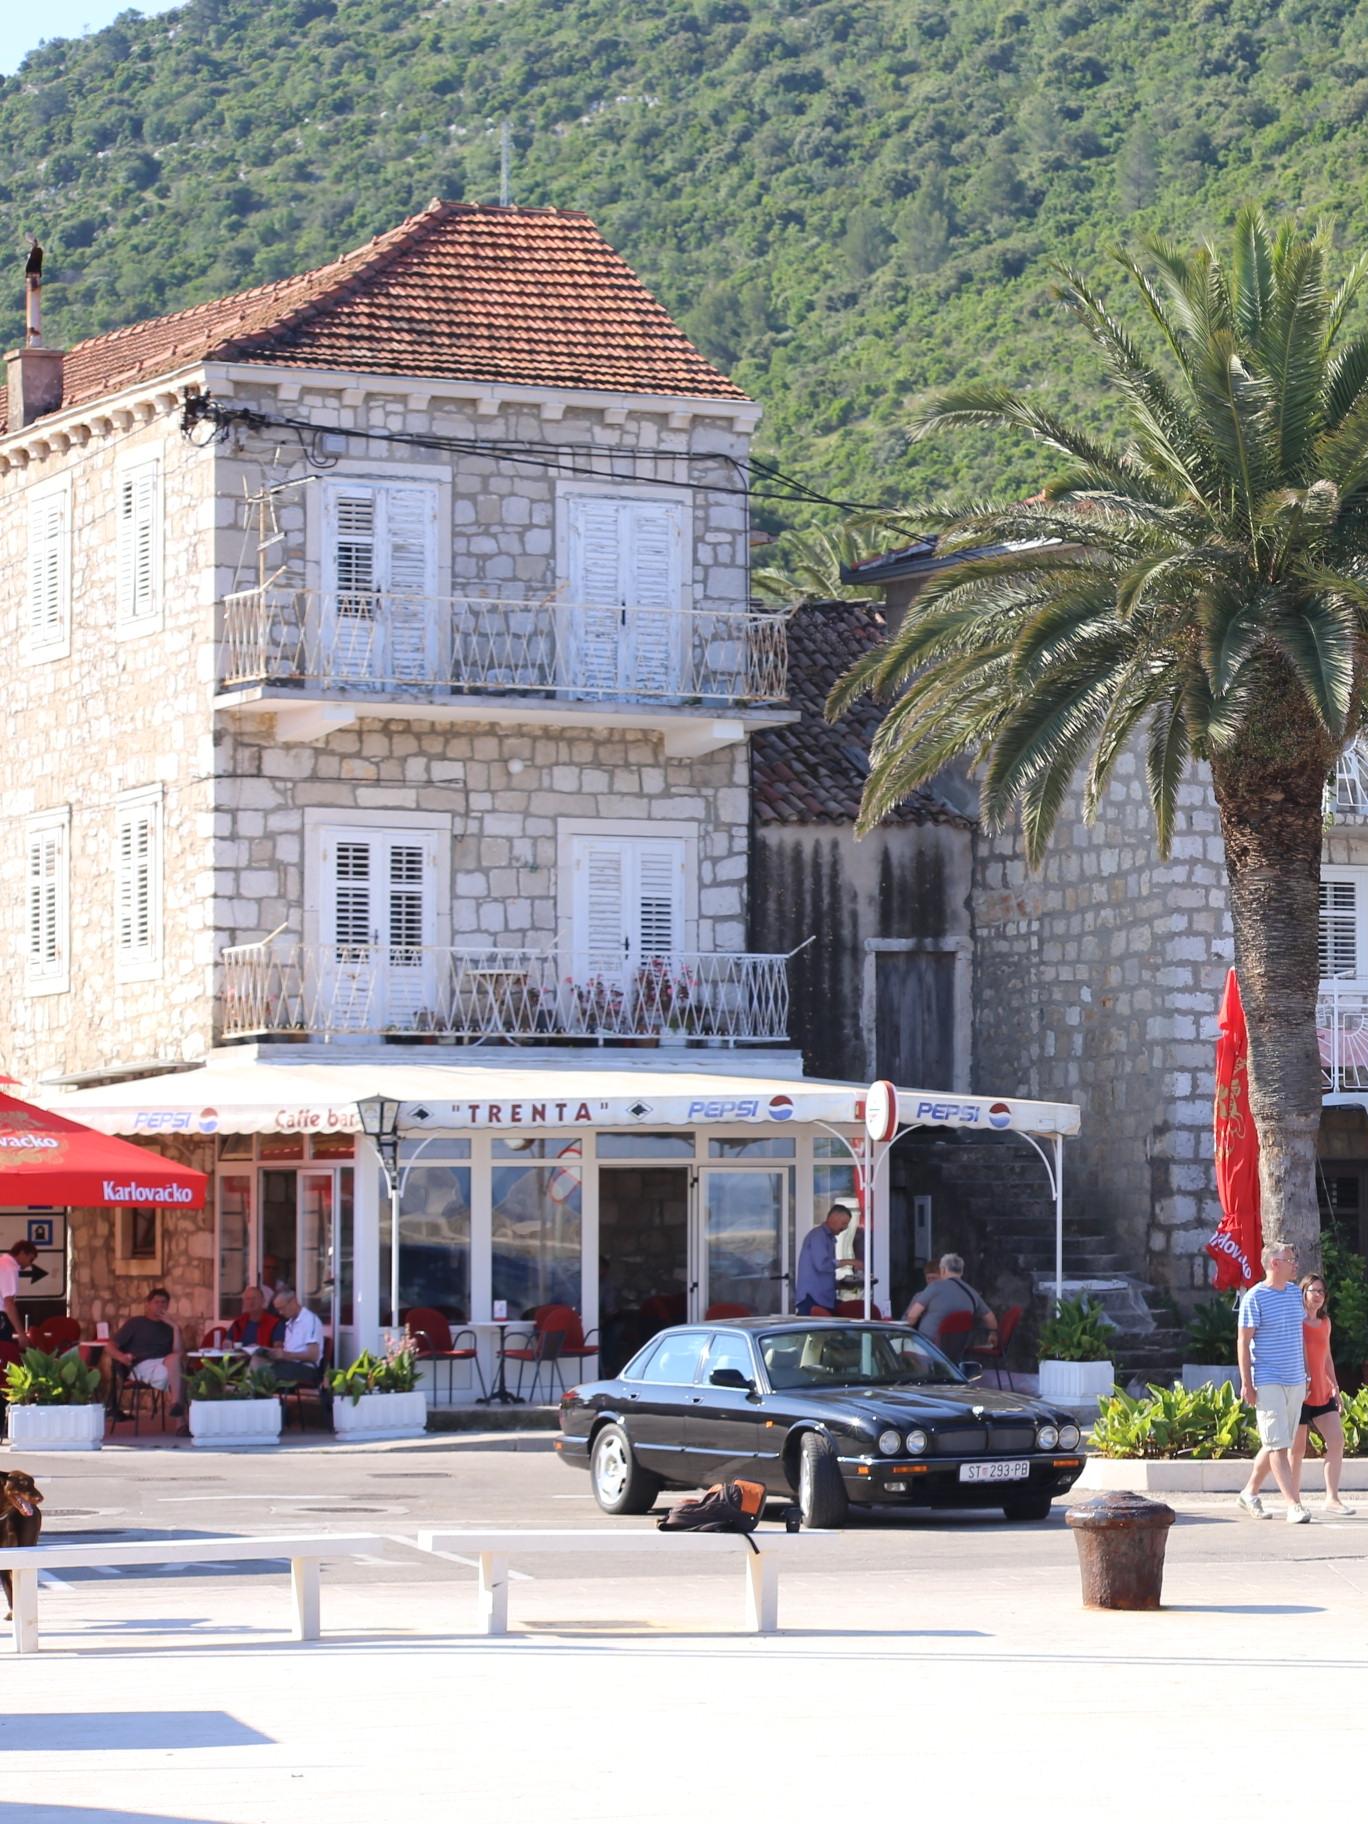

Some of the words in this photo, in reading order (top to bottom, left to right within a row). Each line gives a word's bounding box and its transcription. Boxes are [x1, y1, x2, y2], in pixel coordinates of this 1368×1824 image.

[688, 1100, 759, 1118] PEPSI
[917, 1102, 980, 1122] PEPSI
[134, 1112, 192, 1128] PEPSI
[102, 1180, 193, 1203] Karlovačko
[968, 1465, 981, 1479] ST
[990, 1462, 1028, 1478] 293-PB
